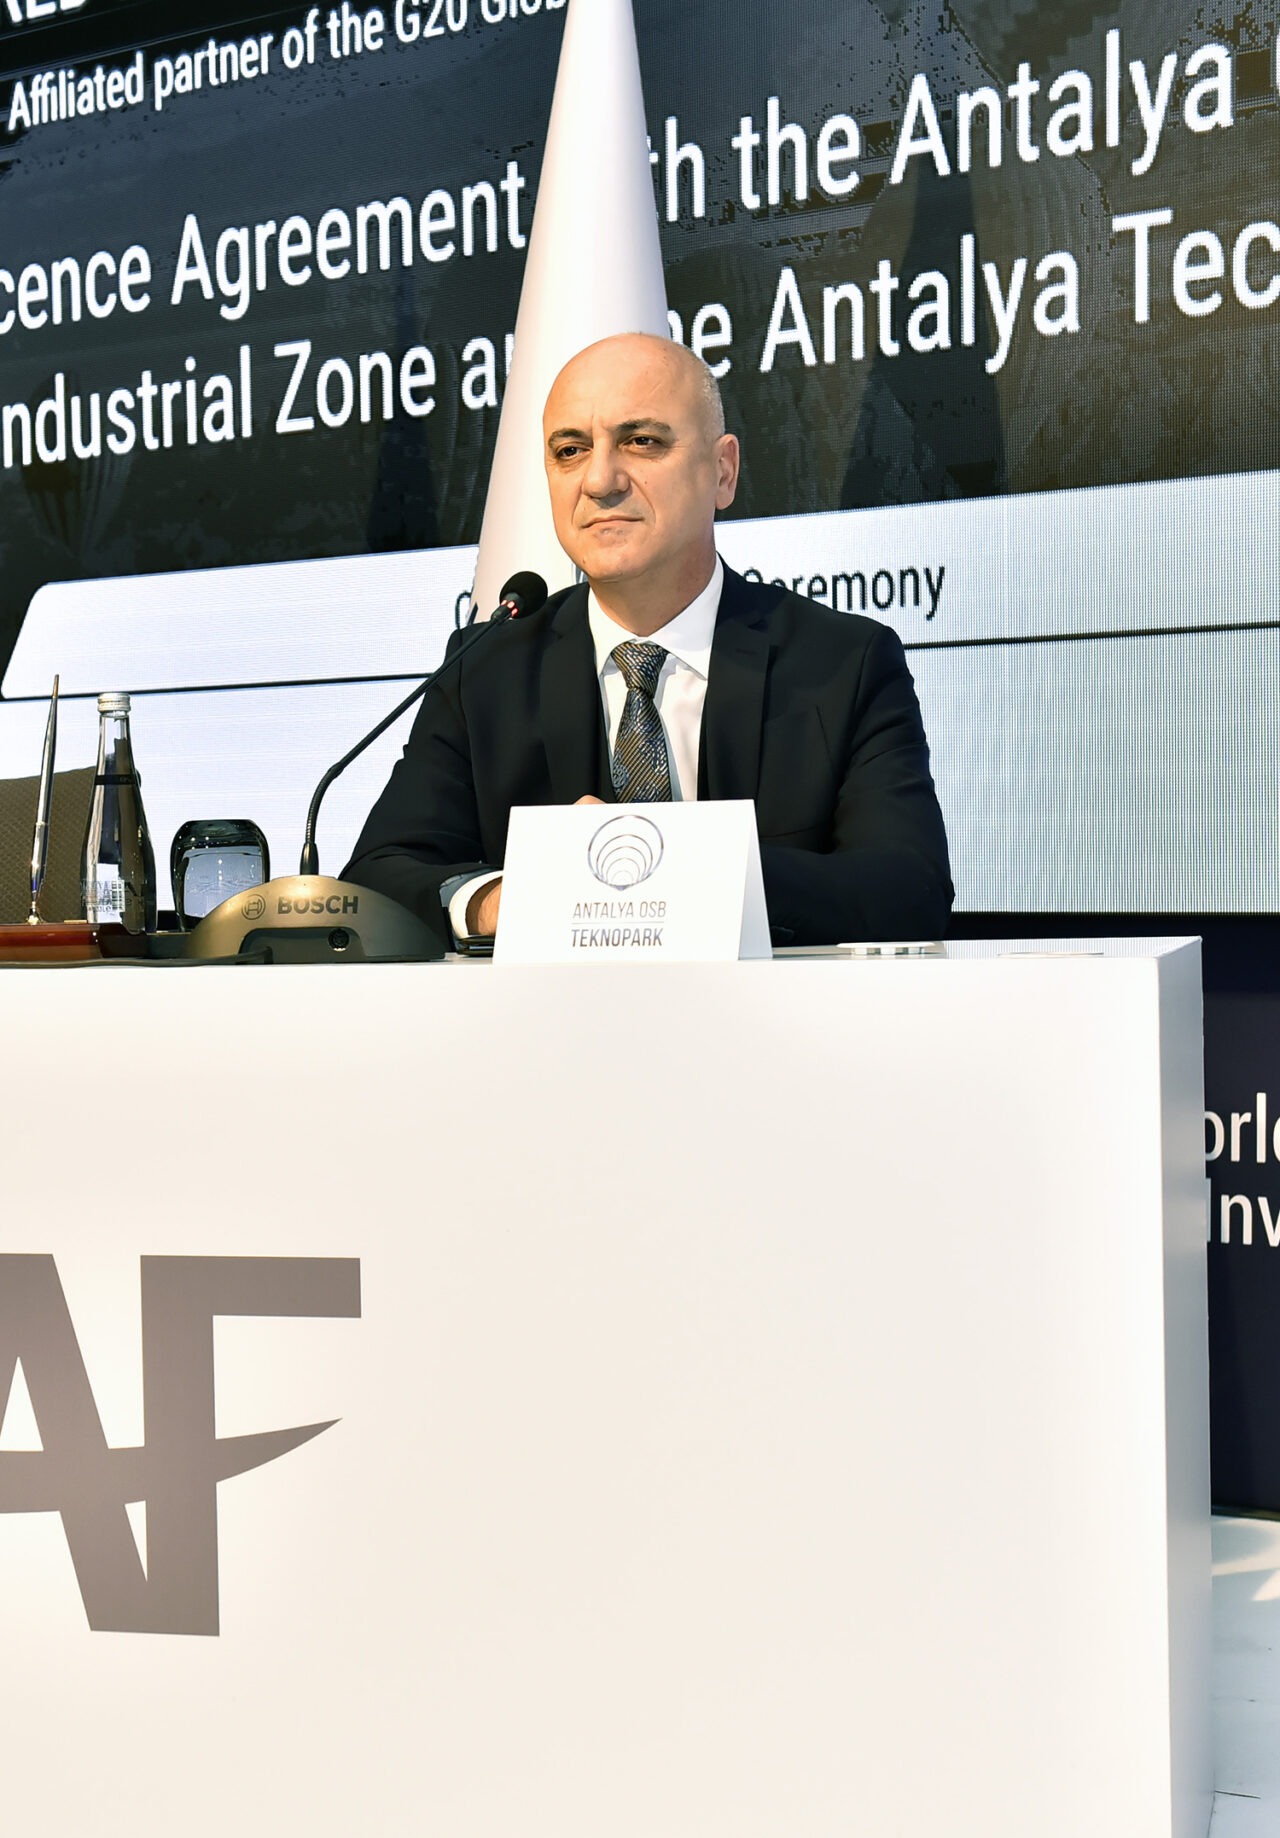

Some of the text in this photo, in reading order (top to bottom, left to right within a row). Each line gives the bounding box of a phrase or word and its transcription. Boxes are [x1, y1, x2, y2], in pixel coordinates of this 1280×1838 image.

[7, 50, 144, 131] Affiliated
[153, 37, 273, 111] partner
[281, 7, 320, 69] of
[326, 0, 385, 59] the
[394, 0, 468, 43] G20
[731, 96, 860, 210] the
[889, 27, 1234, 186] Antalya
[171, 160, 527, 320] Agreement
[760, 233, 1081, 375] Antalya
[1112, 206, 1280, 324] Tec
[274, 338, 437, 436] Zone
[277, 895, 359, 915] BOSCH
[571, 928, 664, 948] TEKNOPARK
[572, 900, 667, 919] ANTALYA OSB
